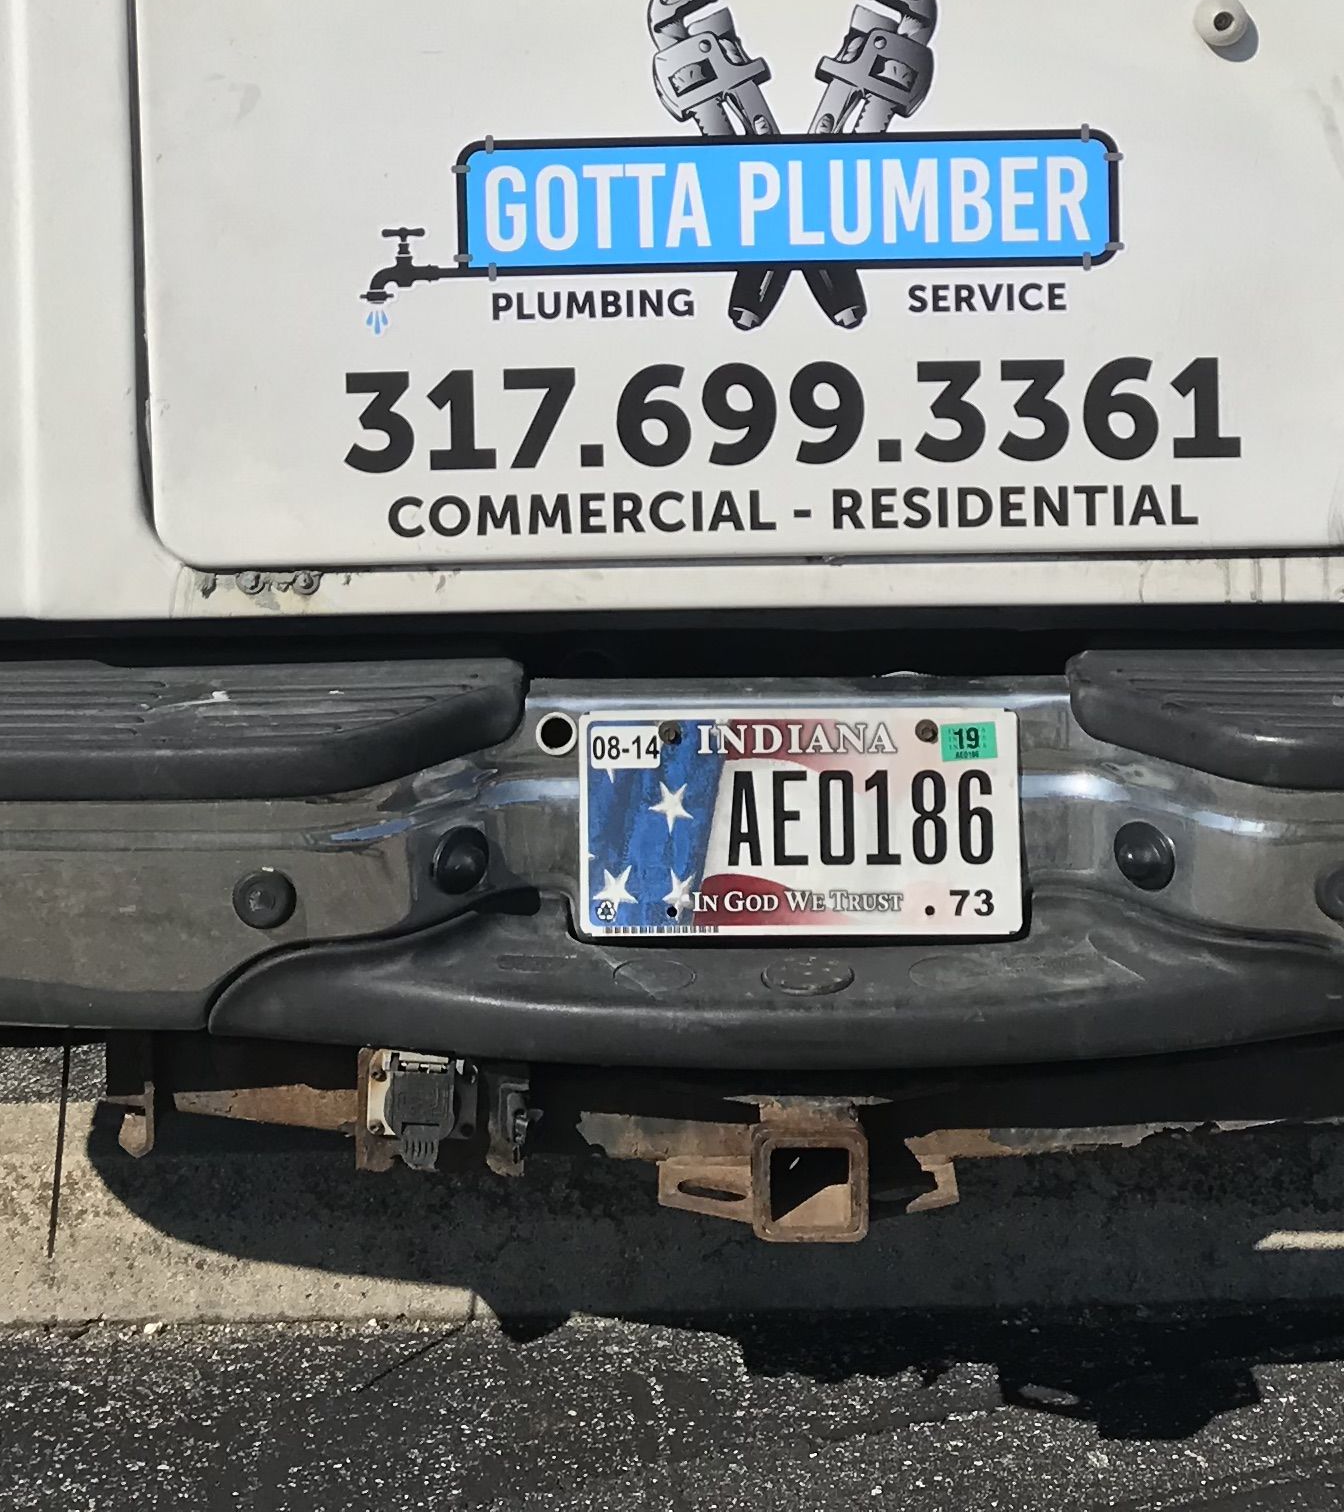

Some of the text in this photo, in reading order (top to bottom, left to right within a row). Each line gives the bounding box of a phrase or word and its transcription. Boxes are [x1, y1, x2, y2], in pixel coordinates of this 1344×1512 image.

[485, 154, 1090, 252] GOTTA PLUMBER
[491, 282, 1067, 321] PLUMBING SERVICE
[343, 355, 1242, 474] 317.699.3361
[388, 490, 776, 538] COMMERCIAL
[831, 483, 1198, 529] RESIDENTIAL
[592, 735, 660, 760] 08-14
[697, 723, 897, 755] INDIANA
[953, 727, 979, 749] 19
[692, 890, 904, 912] IN GOD WE TRUST
[949, 889, 996, 916] 73
